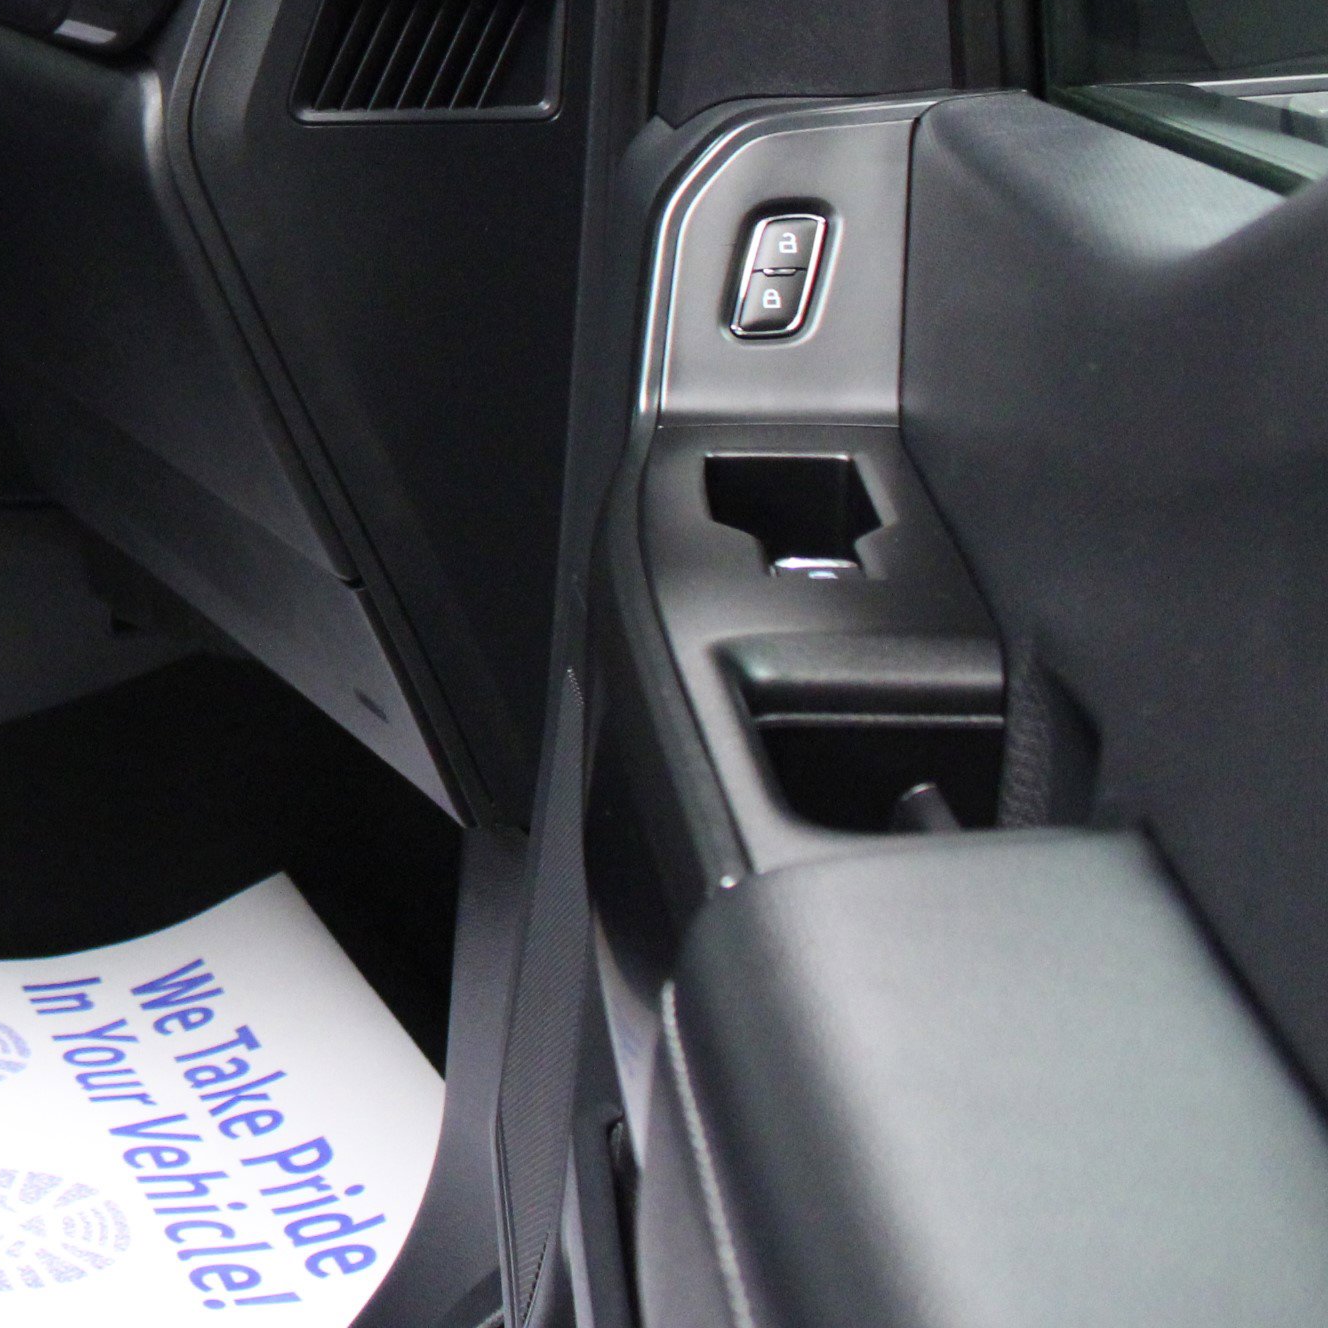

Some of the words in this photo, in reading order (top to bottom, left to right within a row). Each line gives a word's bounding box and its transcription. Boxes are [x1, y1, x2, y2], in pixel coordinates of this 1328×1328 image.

[22, 976, 103, 1016] In
[130, 959, 225, 1036] We
[51, 1018, 158, 1106] Your
[174, 1025, 288, 1140] Take
[108, 1113, 302, 1310] Vehicle!
[239, 1136, 387, 1279] Pride
